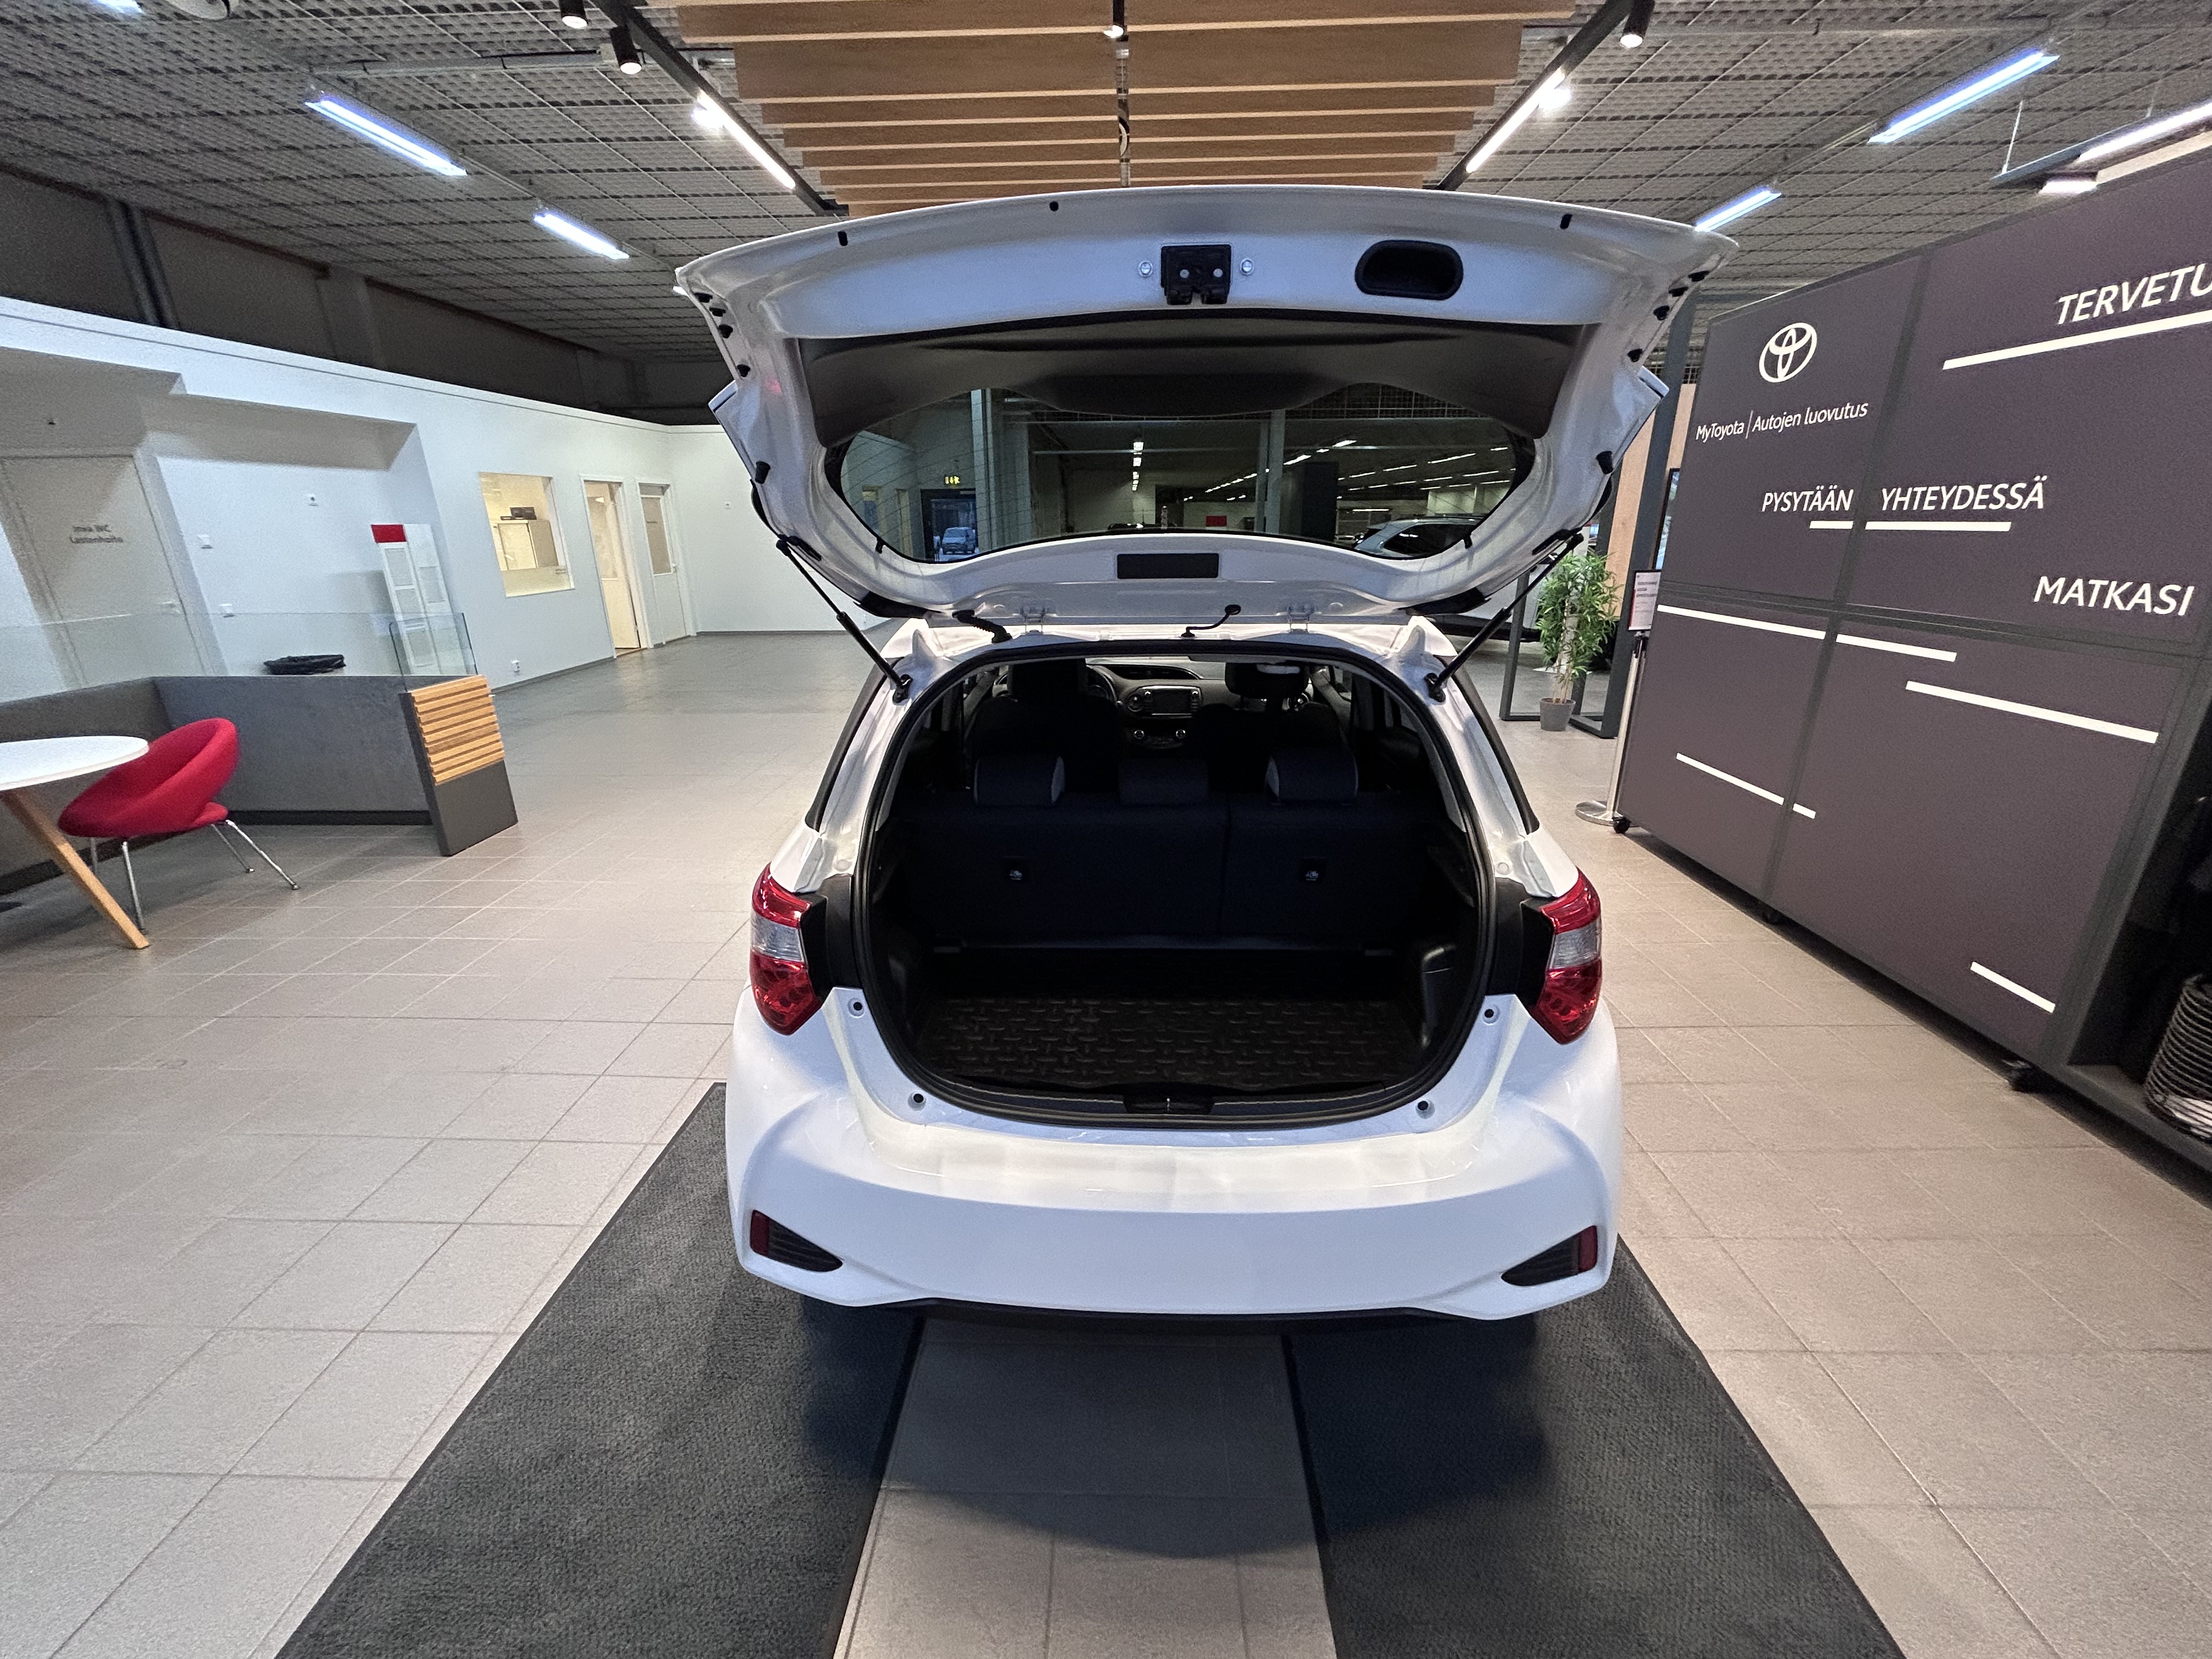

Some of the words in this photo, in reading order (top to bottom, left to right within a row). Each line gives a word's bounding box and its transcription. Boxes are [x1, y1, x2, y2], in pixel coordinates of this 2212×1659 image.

[1695, 420, 1745, 443] MyToyota
[1752, 411, 1802, 433] Autojen
[1804, 403, 1869, 425] luovutus
[1762, 484, 1854, 512] PYSYTÄÄN
[1882, 475, 2047, 511] YHTEYDESSÄ
[2033, 575, 2195, 616] MATKASI
